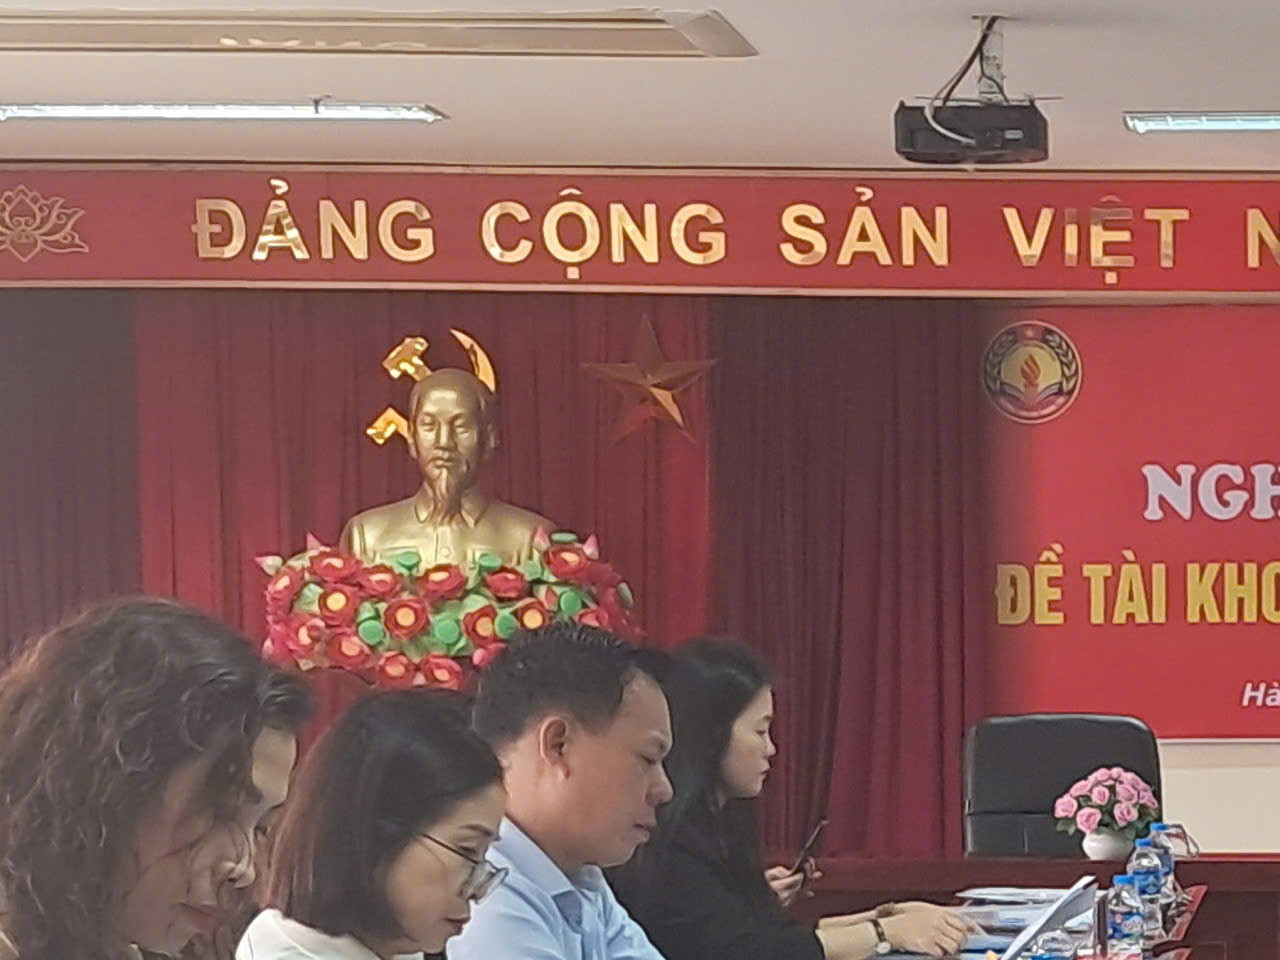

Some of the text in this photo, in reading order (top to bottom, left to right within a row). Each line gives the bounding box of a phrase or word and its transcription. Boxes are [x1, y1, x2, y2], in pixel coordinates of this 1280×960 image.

[190, 178, 435, 262] ĐẢNG
[482, 187, 727, 279] CỘNG
[779, 186, 950, 267] SẢN
[1003, 195, 1190, 284] VIỆT
[995, 543, 1065, 626] ĐỀ
[1083, 550, 1168, 625] TÀI
